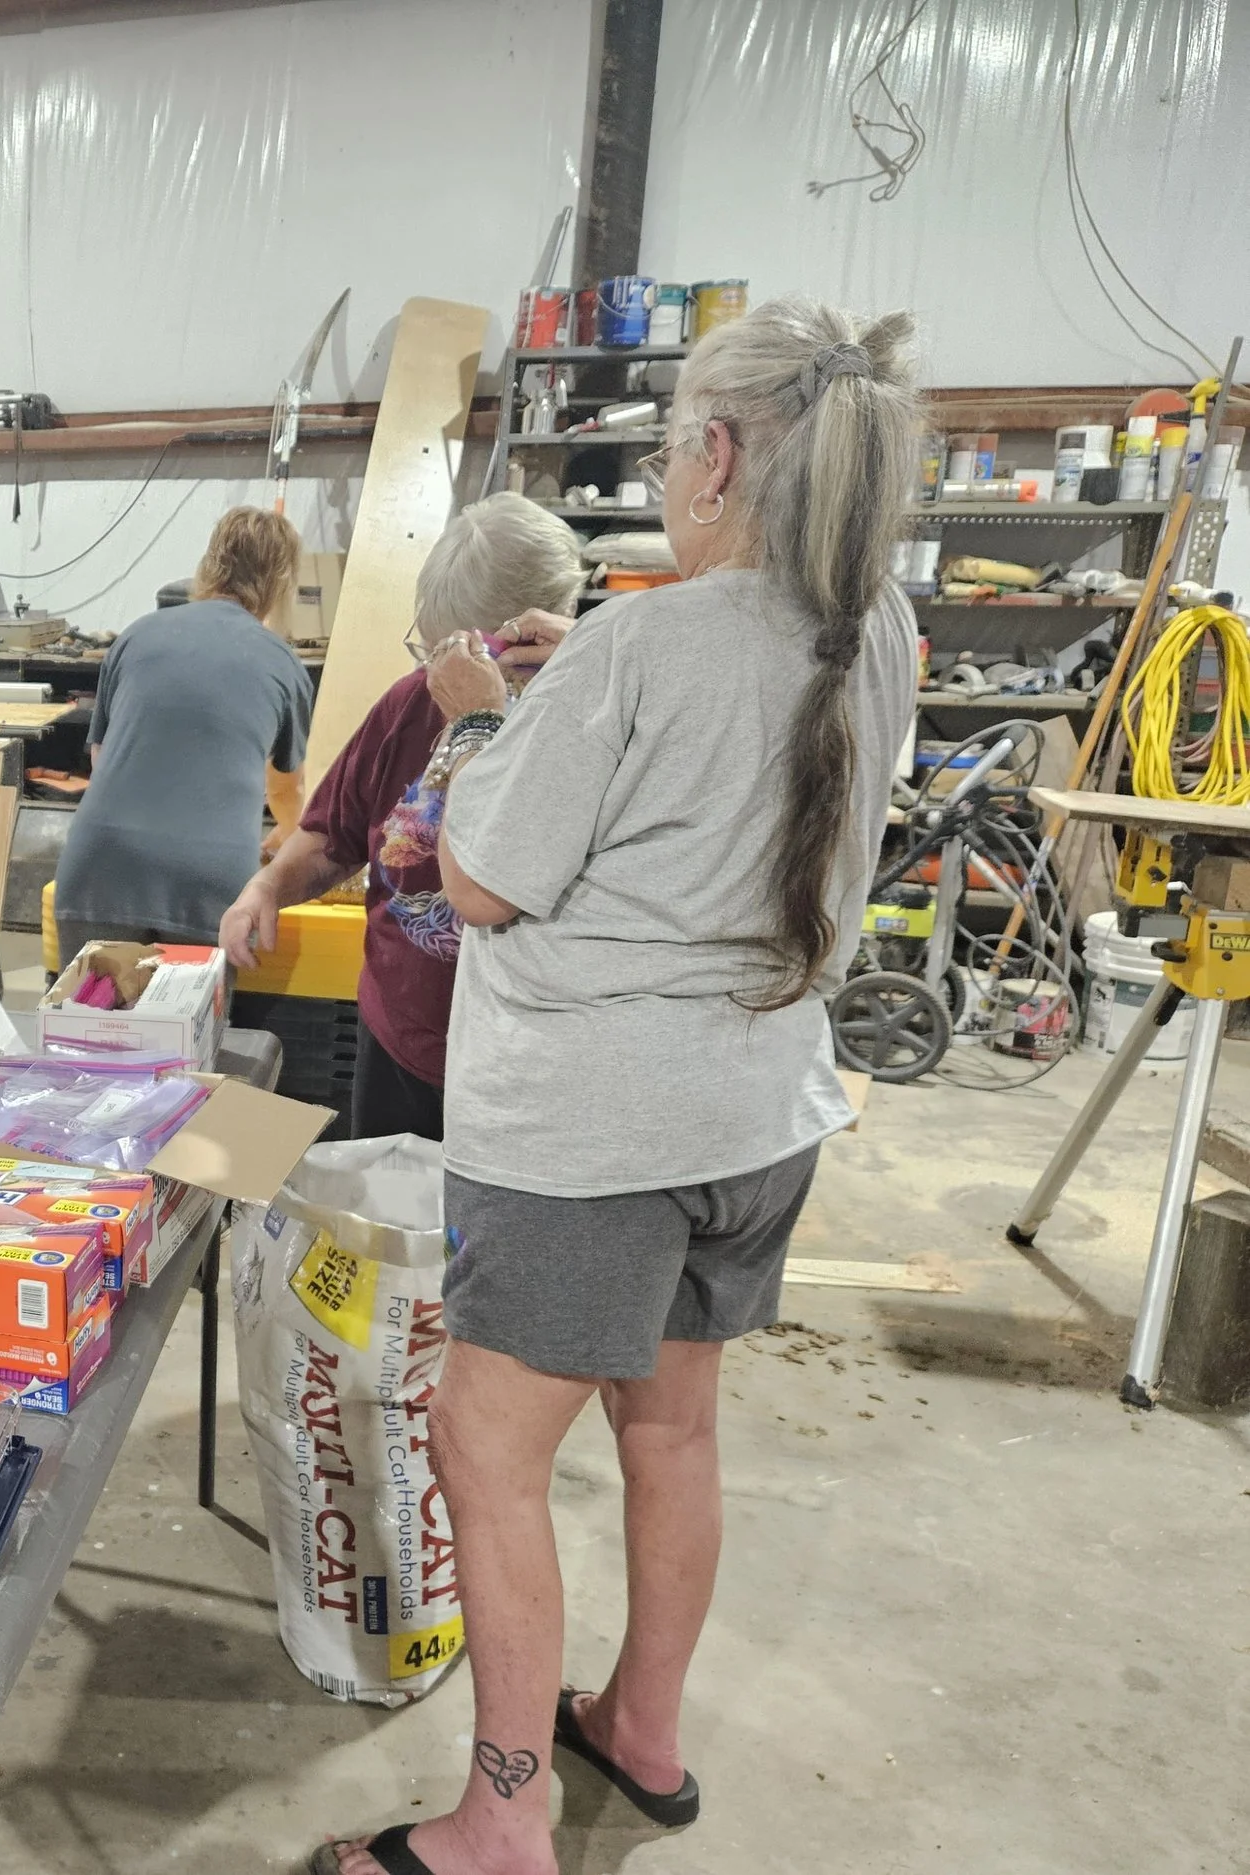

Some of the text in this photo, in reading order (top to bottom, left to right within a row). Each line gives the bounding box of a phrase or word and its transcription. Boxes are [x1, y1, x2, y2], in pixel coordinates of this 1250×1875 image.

[306, 1246, 339, 1299] SIZE
[386, 1296, 409, 1328] For
[20, 1397, 63, 1411] STRONGER
[42, 1393, 63, 1403] SEAL
[387, 1446, 409, 1486] Cat
[300, 1507, 316, 1613] Households
[396, 1490, 417, 1620] Households
[404, 1634, 441, 1669] 44
